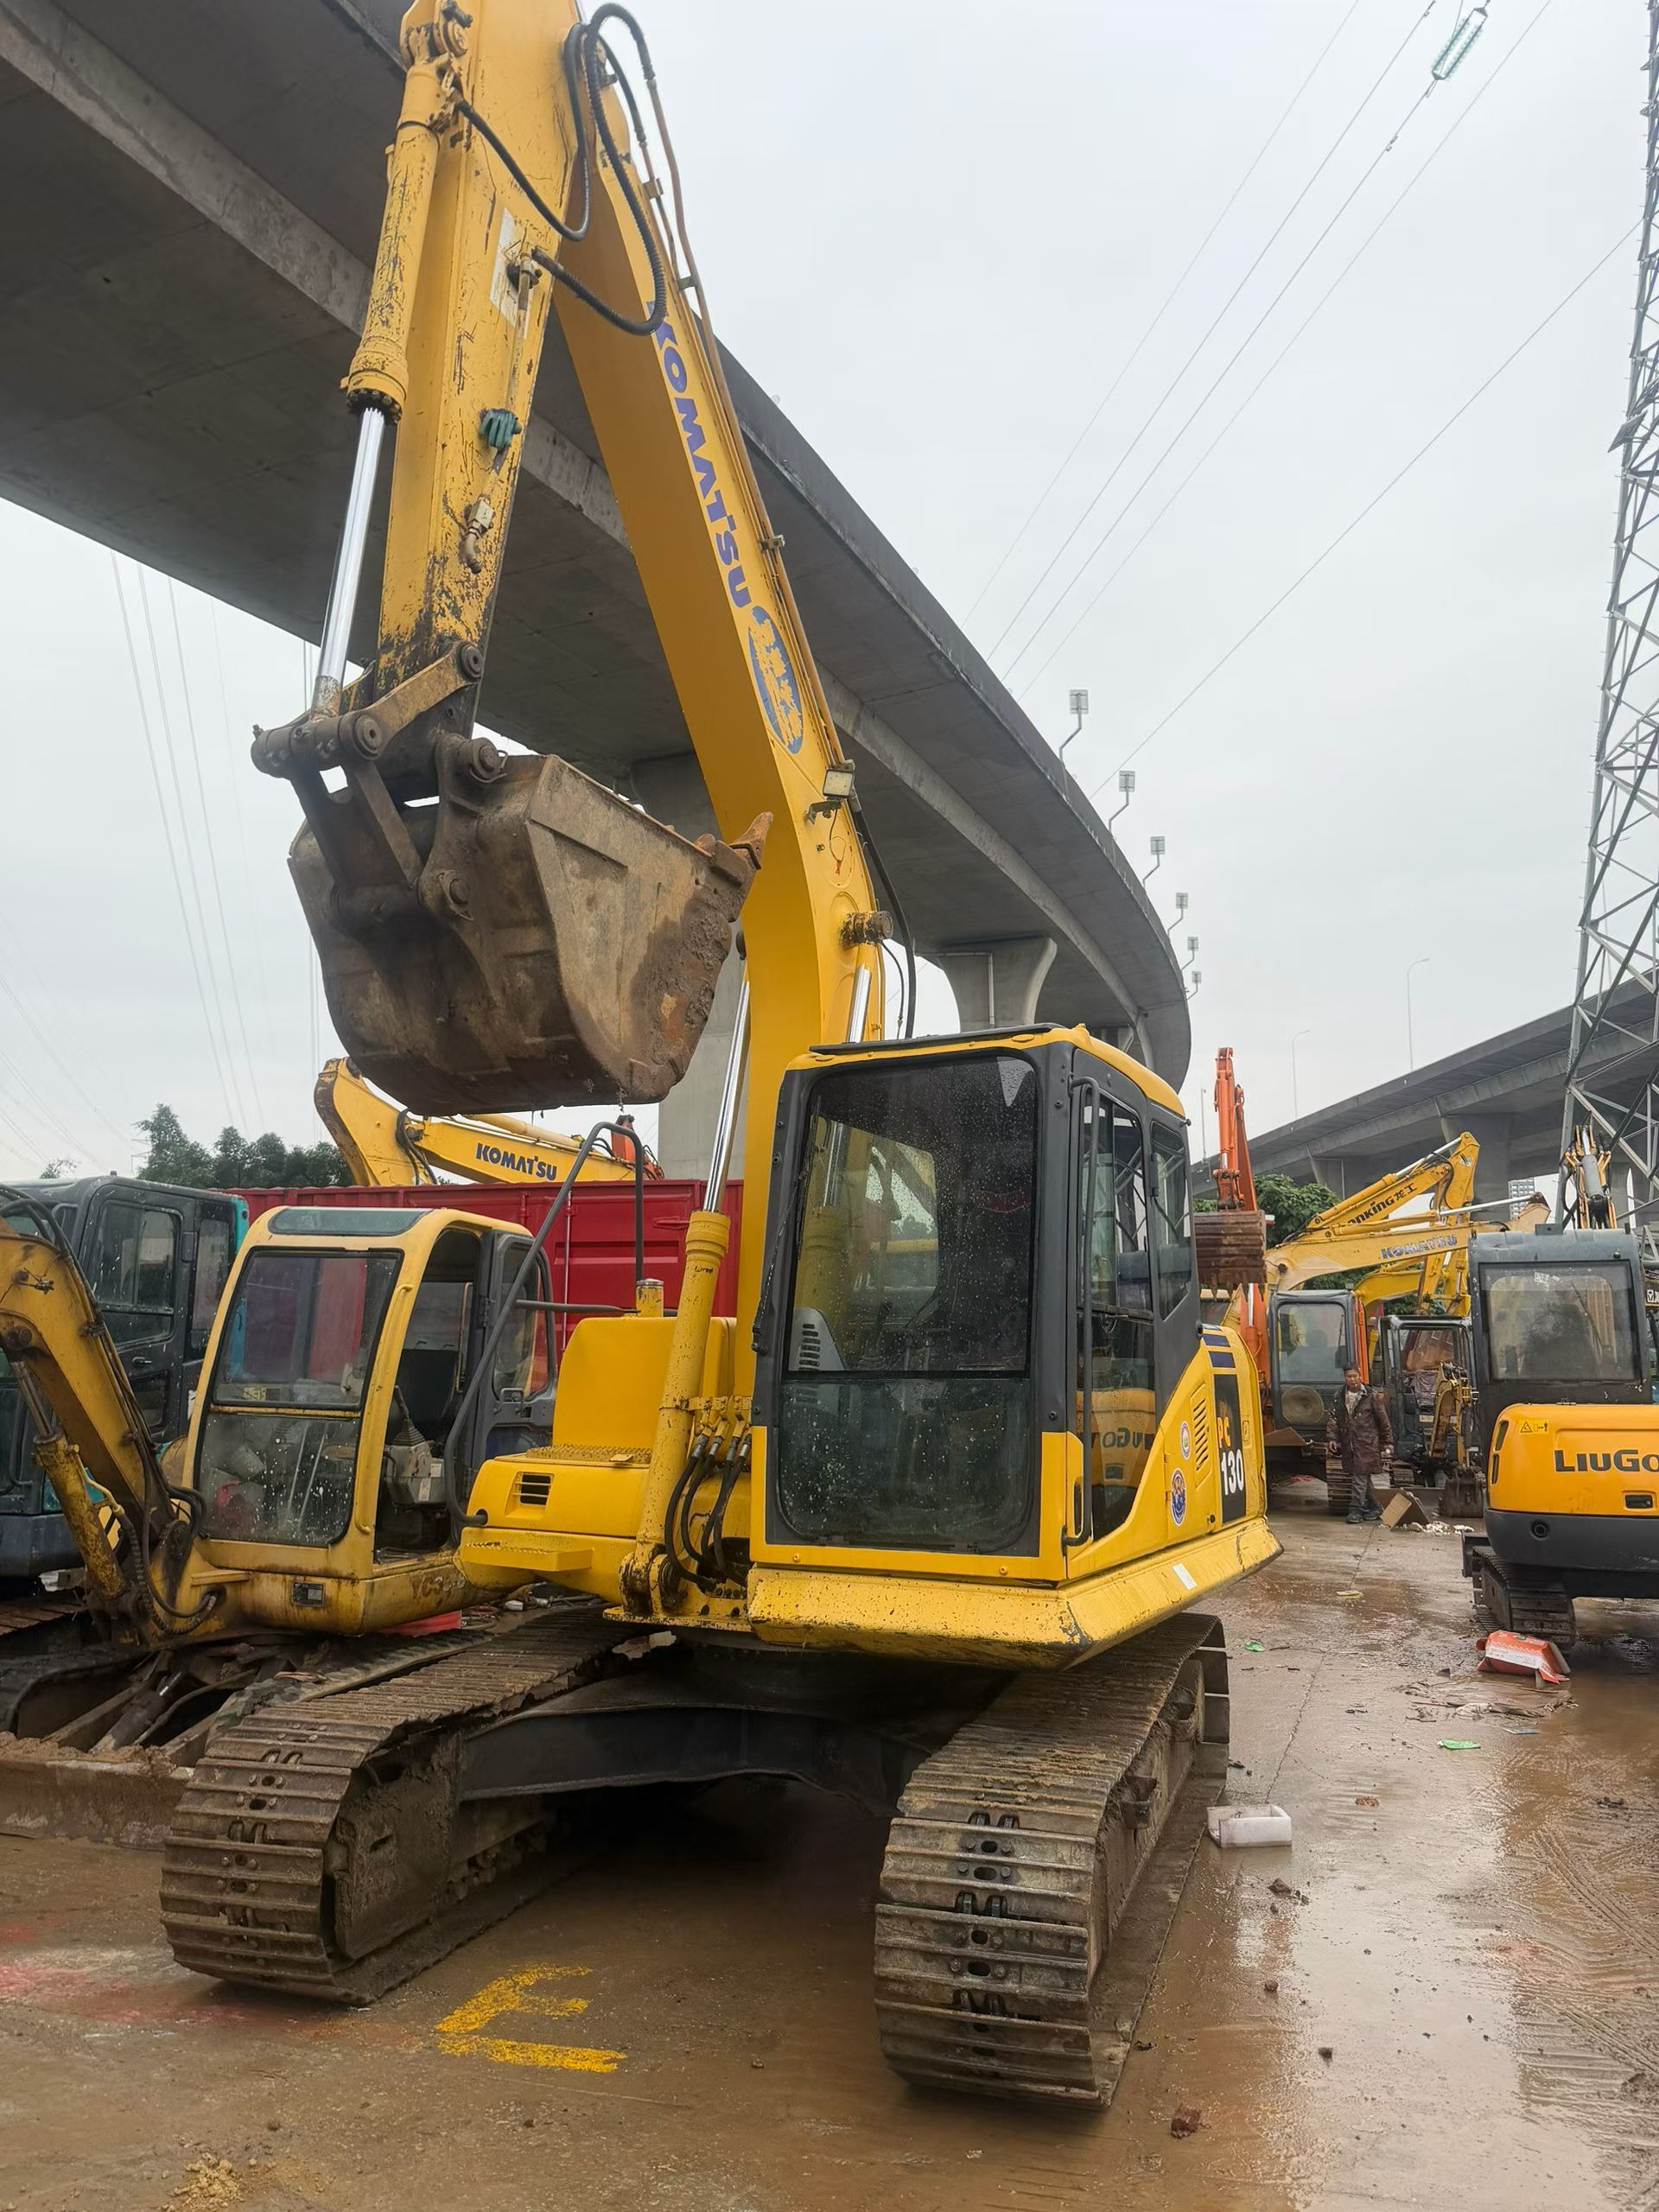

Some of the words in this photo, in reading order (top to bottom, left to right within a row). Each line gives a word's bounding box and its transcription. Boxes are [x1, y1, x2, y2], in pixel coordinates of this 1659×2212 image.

[475, 1142, 558, 1181] KOMATSU
[1380, 1233, 1459, 1260] KOMATSU
[1217, 1416, 1231, 1448] PC
[1221, 1448, 1244, 1496] 130
